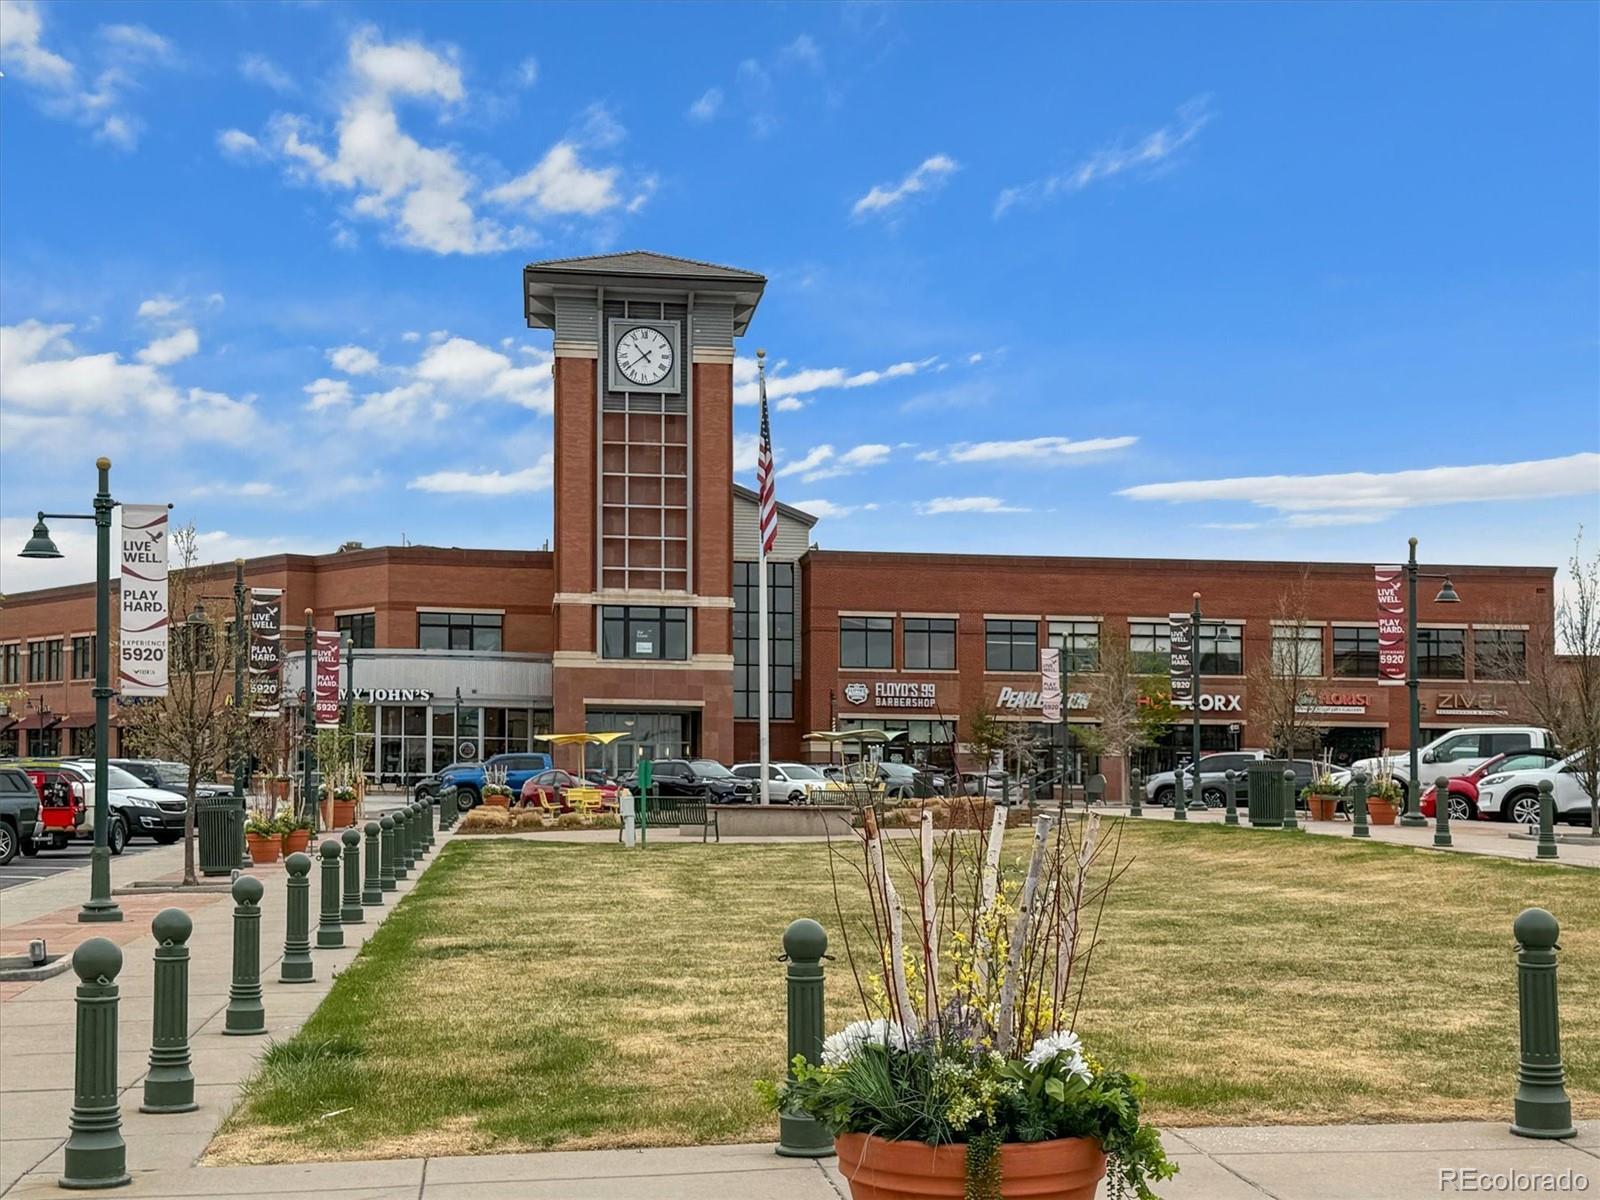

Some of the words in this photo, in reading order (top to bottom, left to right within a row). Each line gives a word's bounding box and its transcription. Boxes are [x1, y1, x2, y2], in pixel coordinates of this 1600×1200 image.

[123, 541, 151, 551] LIVE
[123, 552, 162, 563] WELL.
[123, 590, 158, 600] PLAY
[123, 602, 166, 612] HARD.
[252, 613, 270, 621] LIVE
[251, 621, 277, 629] WELL.
[251, 654, 279, 662] HARD.
[875, 683, 918, 696] FLOYD'S
[921, 683, 935, 697] 99
[368, 688, 430, 703] JOHN'S
[875, 698, 936, 707] BARBERSHOP
[1438, 694, 1508, 709] ZIVEL
